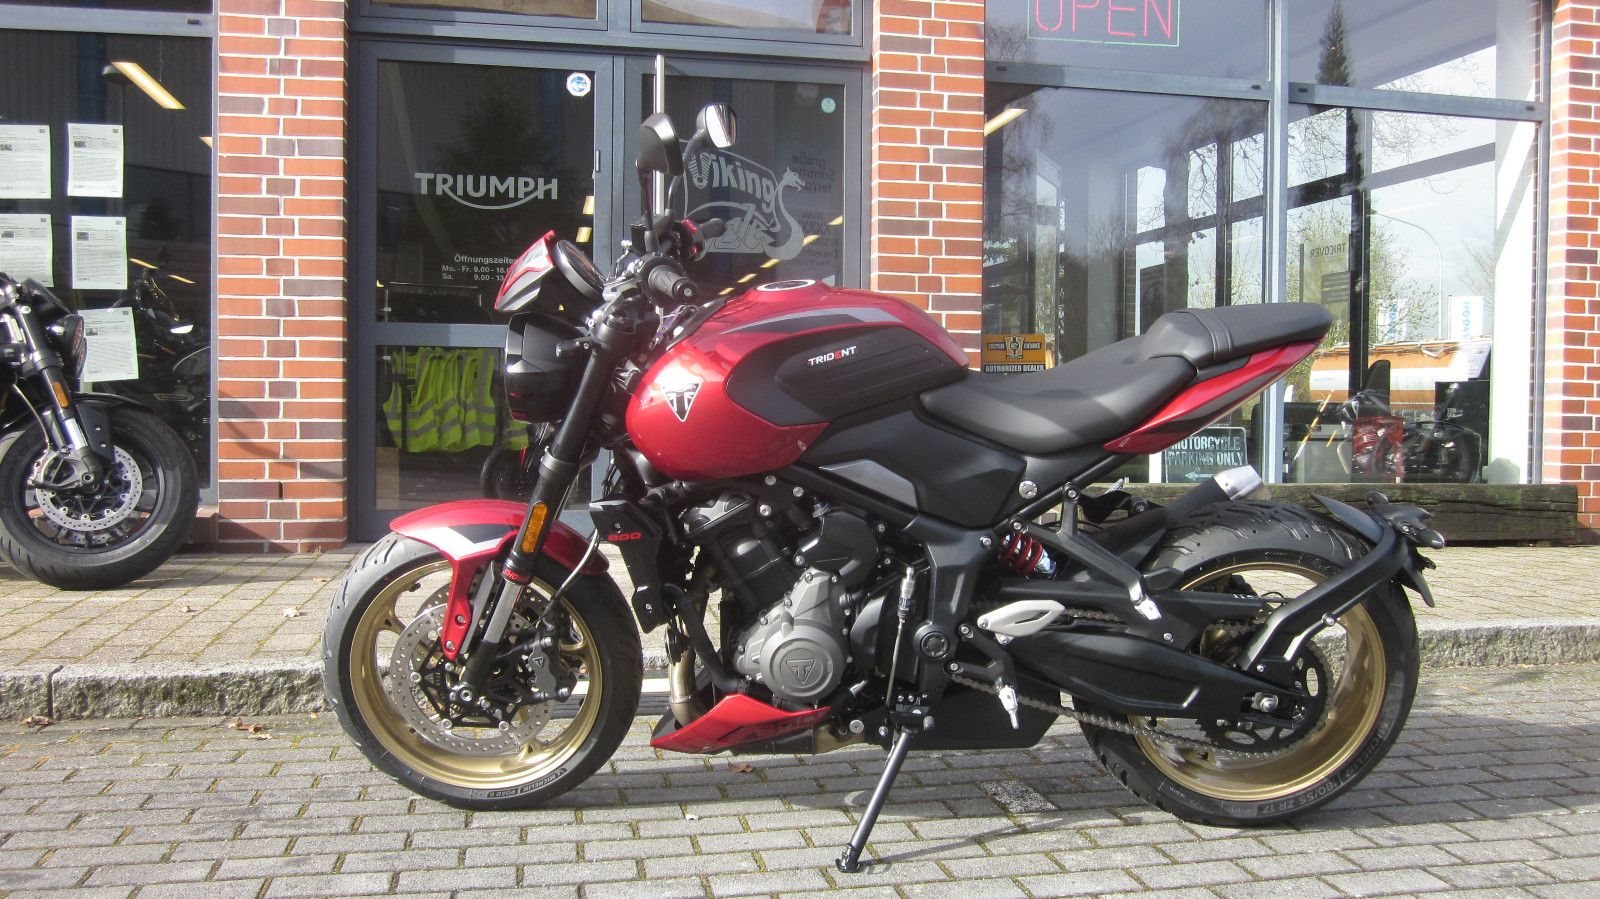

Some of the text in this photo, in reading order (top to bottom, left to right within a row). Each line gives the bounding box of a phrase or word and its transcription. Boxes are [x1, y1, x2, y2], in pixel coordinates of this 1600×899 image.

[1036, 0, 1172, 39] OPEN
[414, 172, 558, 210] TRIUMPH
[454, 253, 518, 265] Öffnungszeite
[807, 345, 857, 366] TRIDENT
[985, 364, 1044, 373] AUTHORIZED DEALER
[1168, 451, 1244, 466] PARKING ONLY
